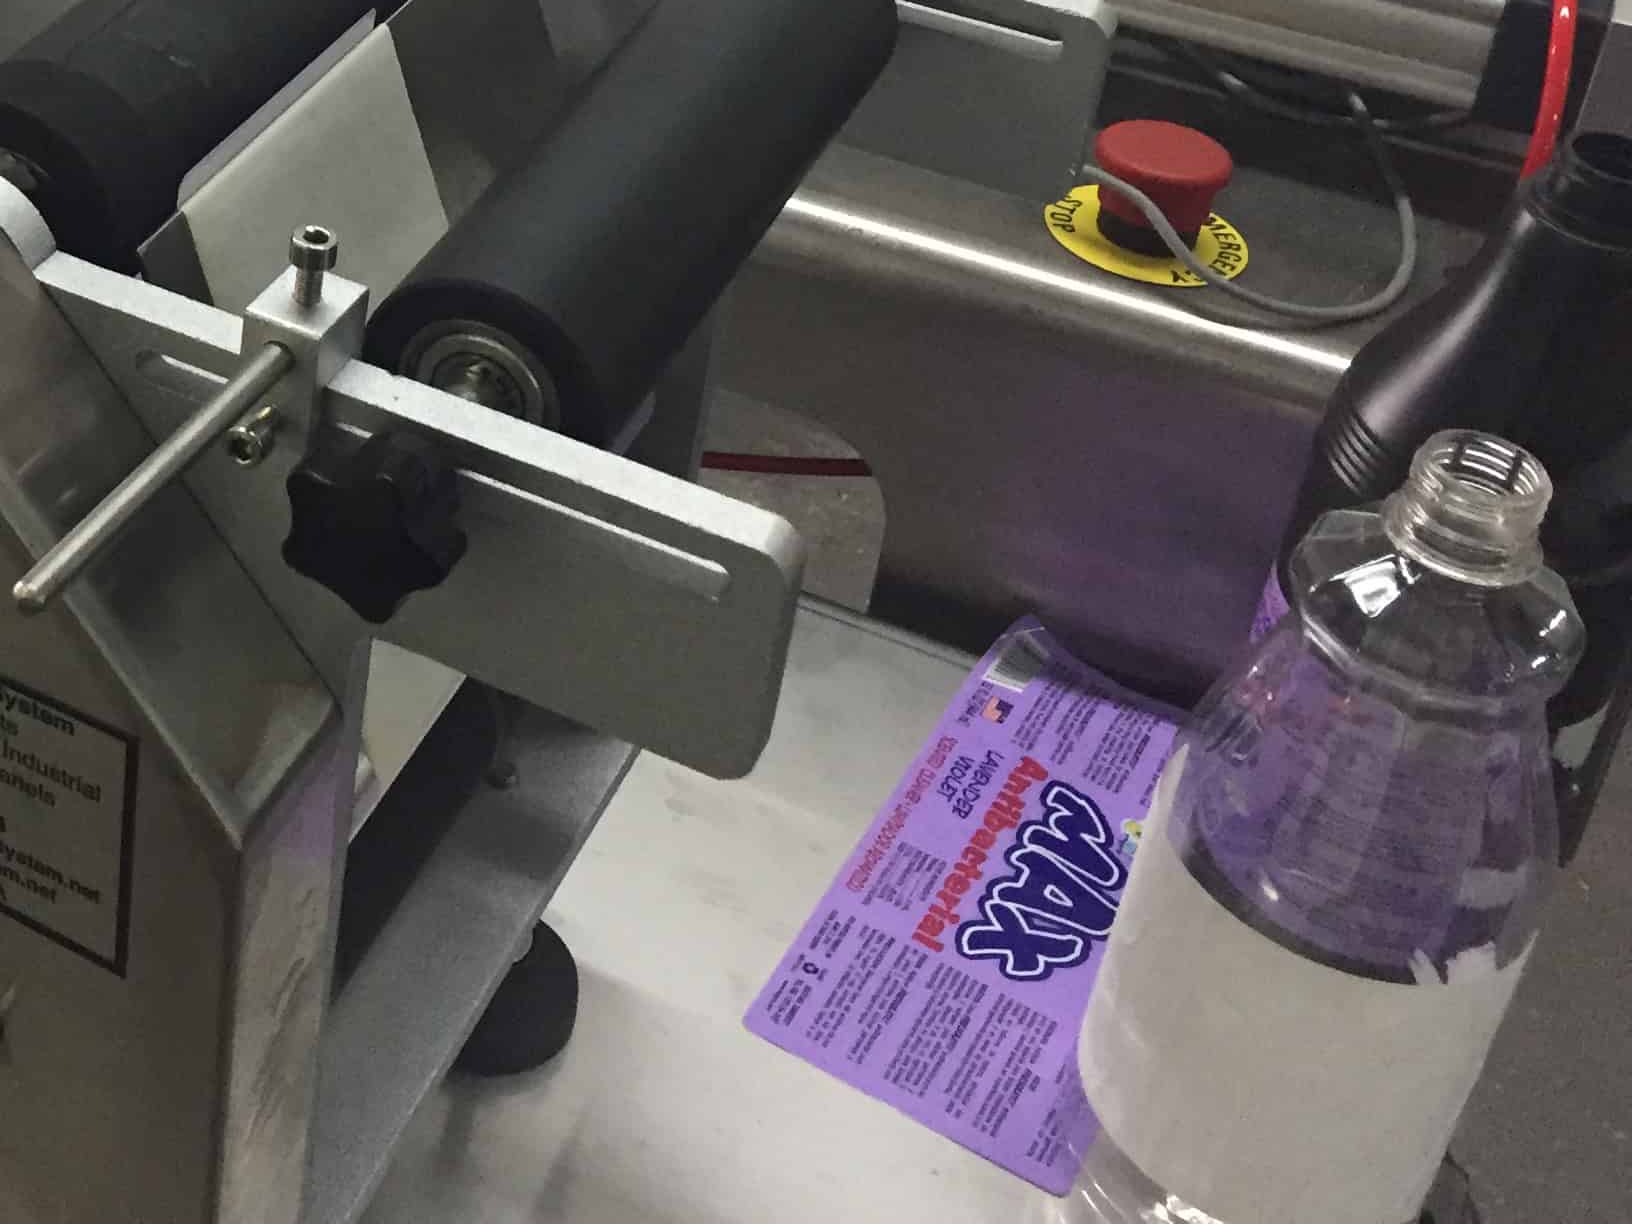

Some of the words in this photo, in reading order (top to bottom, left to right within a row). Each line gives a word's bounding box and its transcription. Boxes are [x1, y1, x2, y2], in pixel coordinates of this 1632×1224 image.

[1050, 198, 1083, 233] STOP
[2, 740, 100, 803] Industrial
[937, 755, 974, 802] VIOLET
[952, 749, 1004, 819] LAVENDER
[912, 755, 1048, 953] Antibacterial
[955, 779, 1128, 981] MAX
